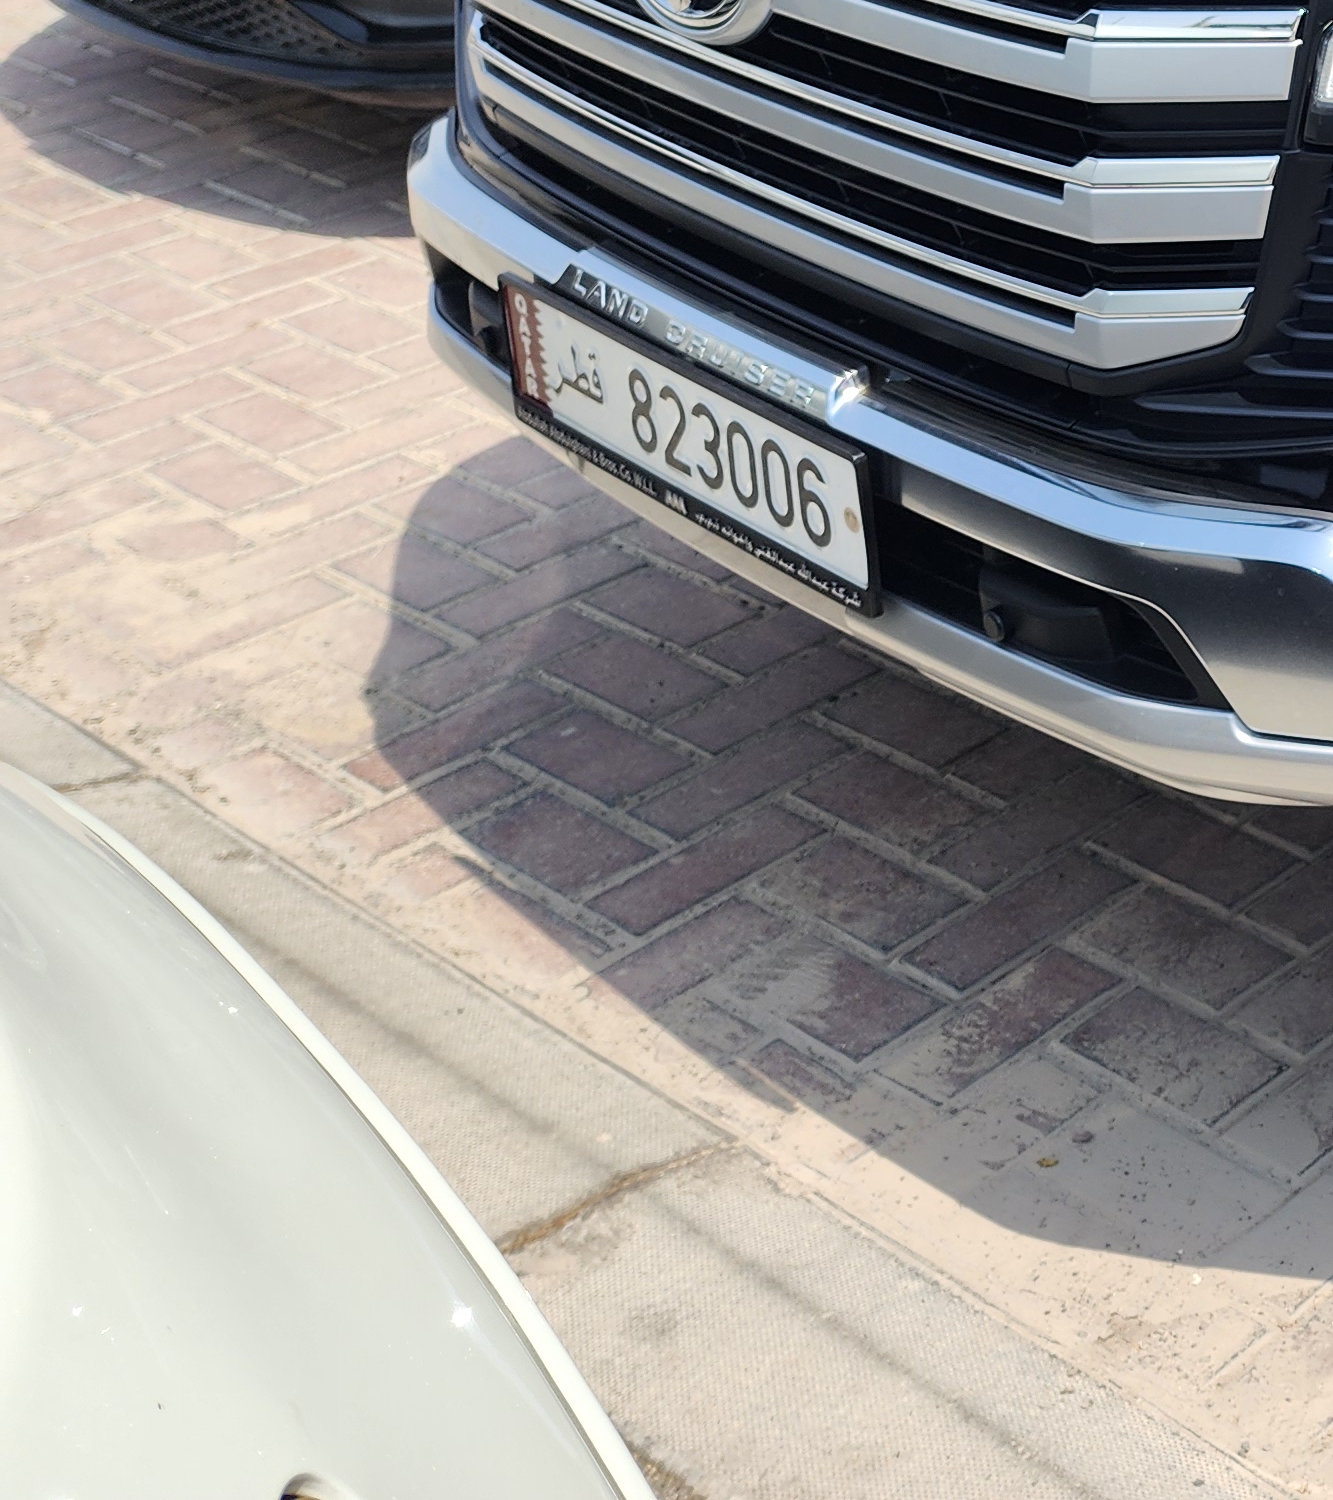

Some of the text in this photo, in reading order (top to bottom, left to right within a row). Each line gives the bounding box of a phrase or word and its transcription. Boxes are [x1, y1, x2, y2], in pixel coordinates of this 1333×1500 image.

[514, 292, 541, 400] QATAR
[548, 344, 605, 405] قطر
[573, 269, 815, 408] LAND CRUISER
[628, 367, 832, 548] 823006
